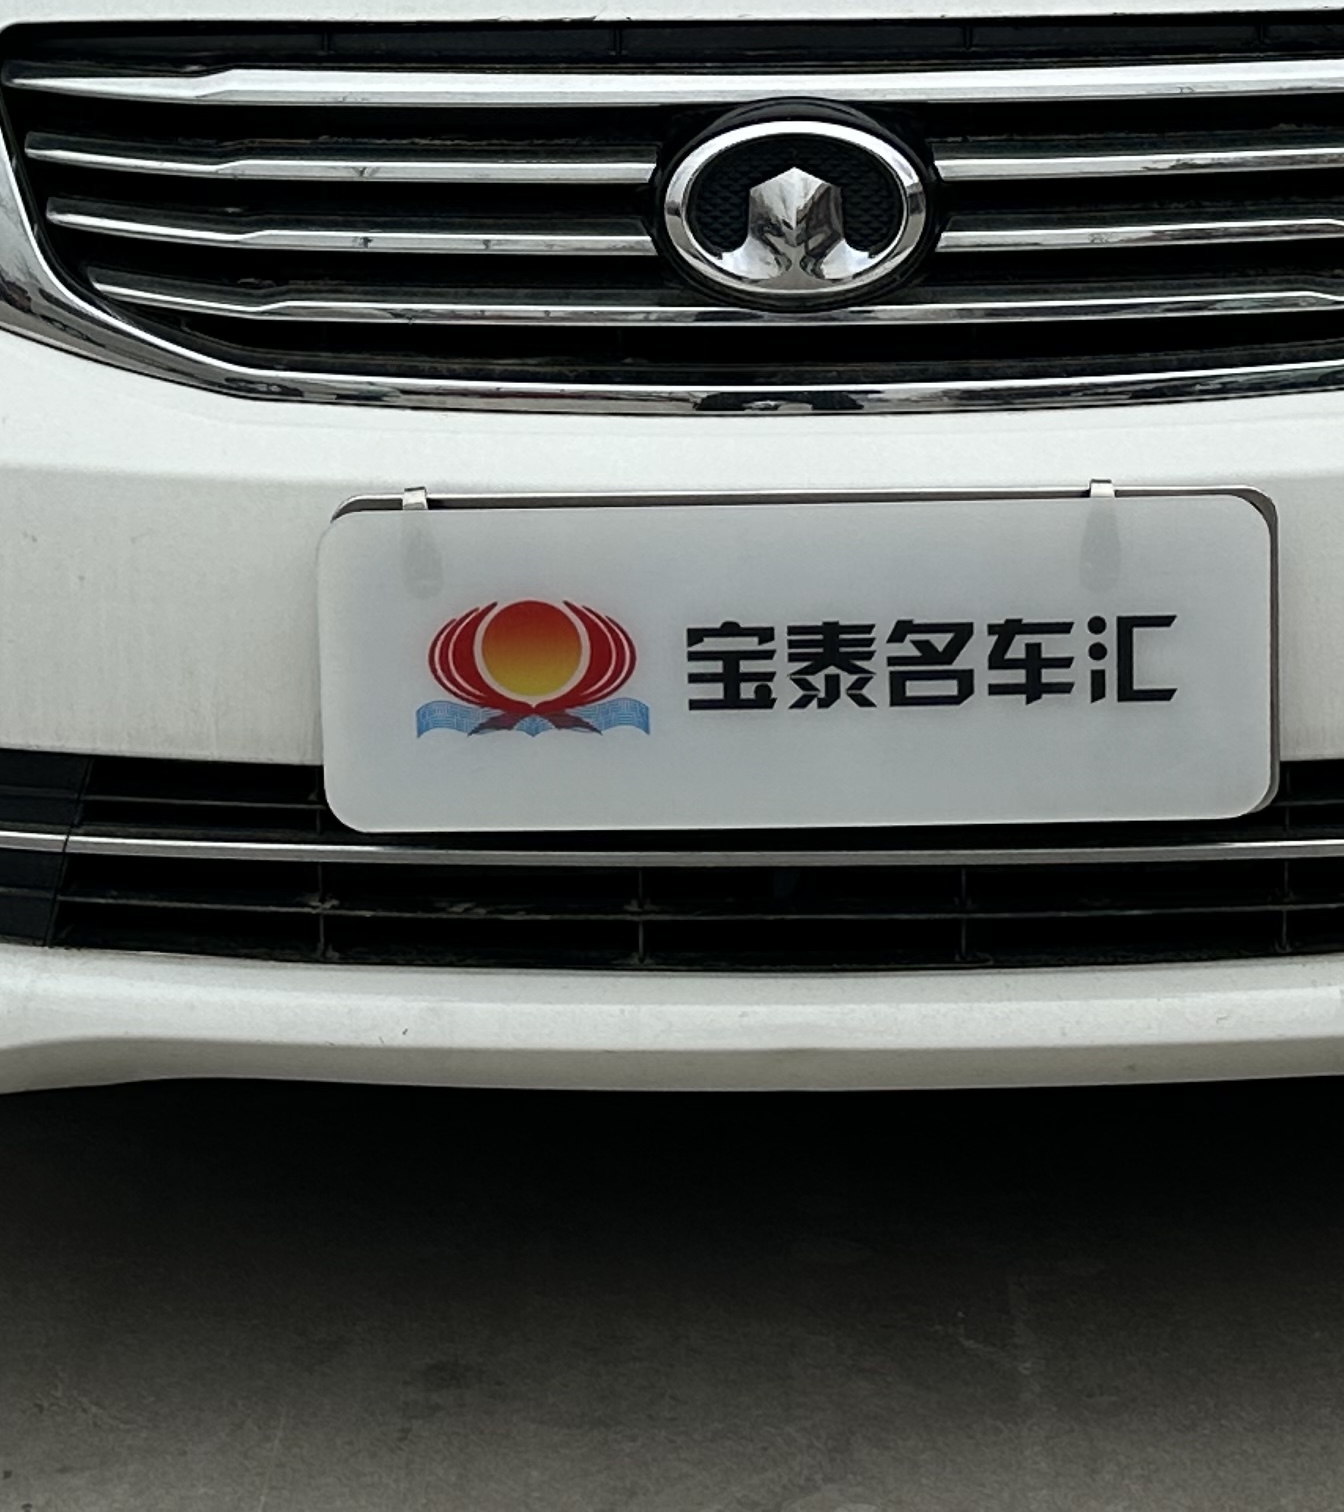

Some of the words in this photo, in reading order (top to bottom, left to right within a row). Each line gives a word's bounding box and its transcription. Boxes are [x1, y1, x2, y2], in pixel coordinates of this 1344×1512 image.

[686, 613, 1178, 711] 宝泰名车汇
